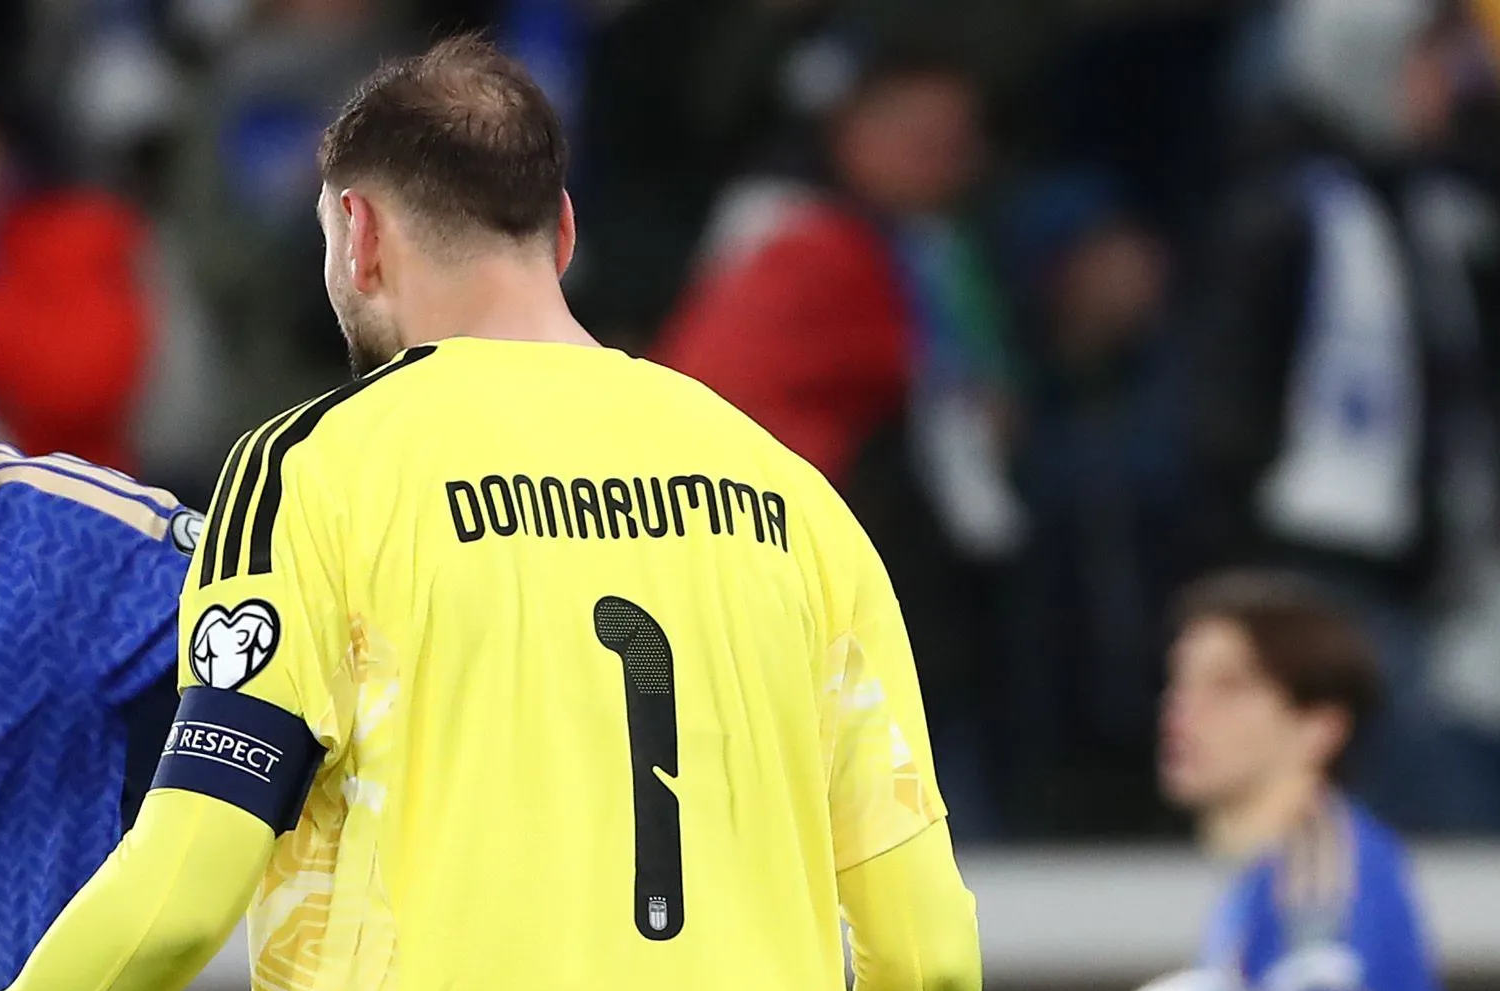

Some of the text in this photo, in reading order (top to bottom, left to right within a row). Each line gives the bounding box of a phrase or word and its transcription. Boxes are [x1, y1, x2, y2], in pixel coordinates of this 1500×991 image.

[446, 474, 788, 553] DONNARUMMA
[179, 728, 280, 773] RESPECT
[593, 595, 684, 941] 1
